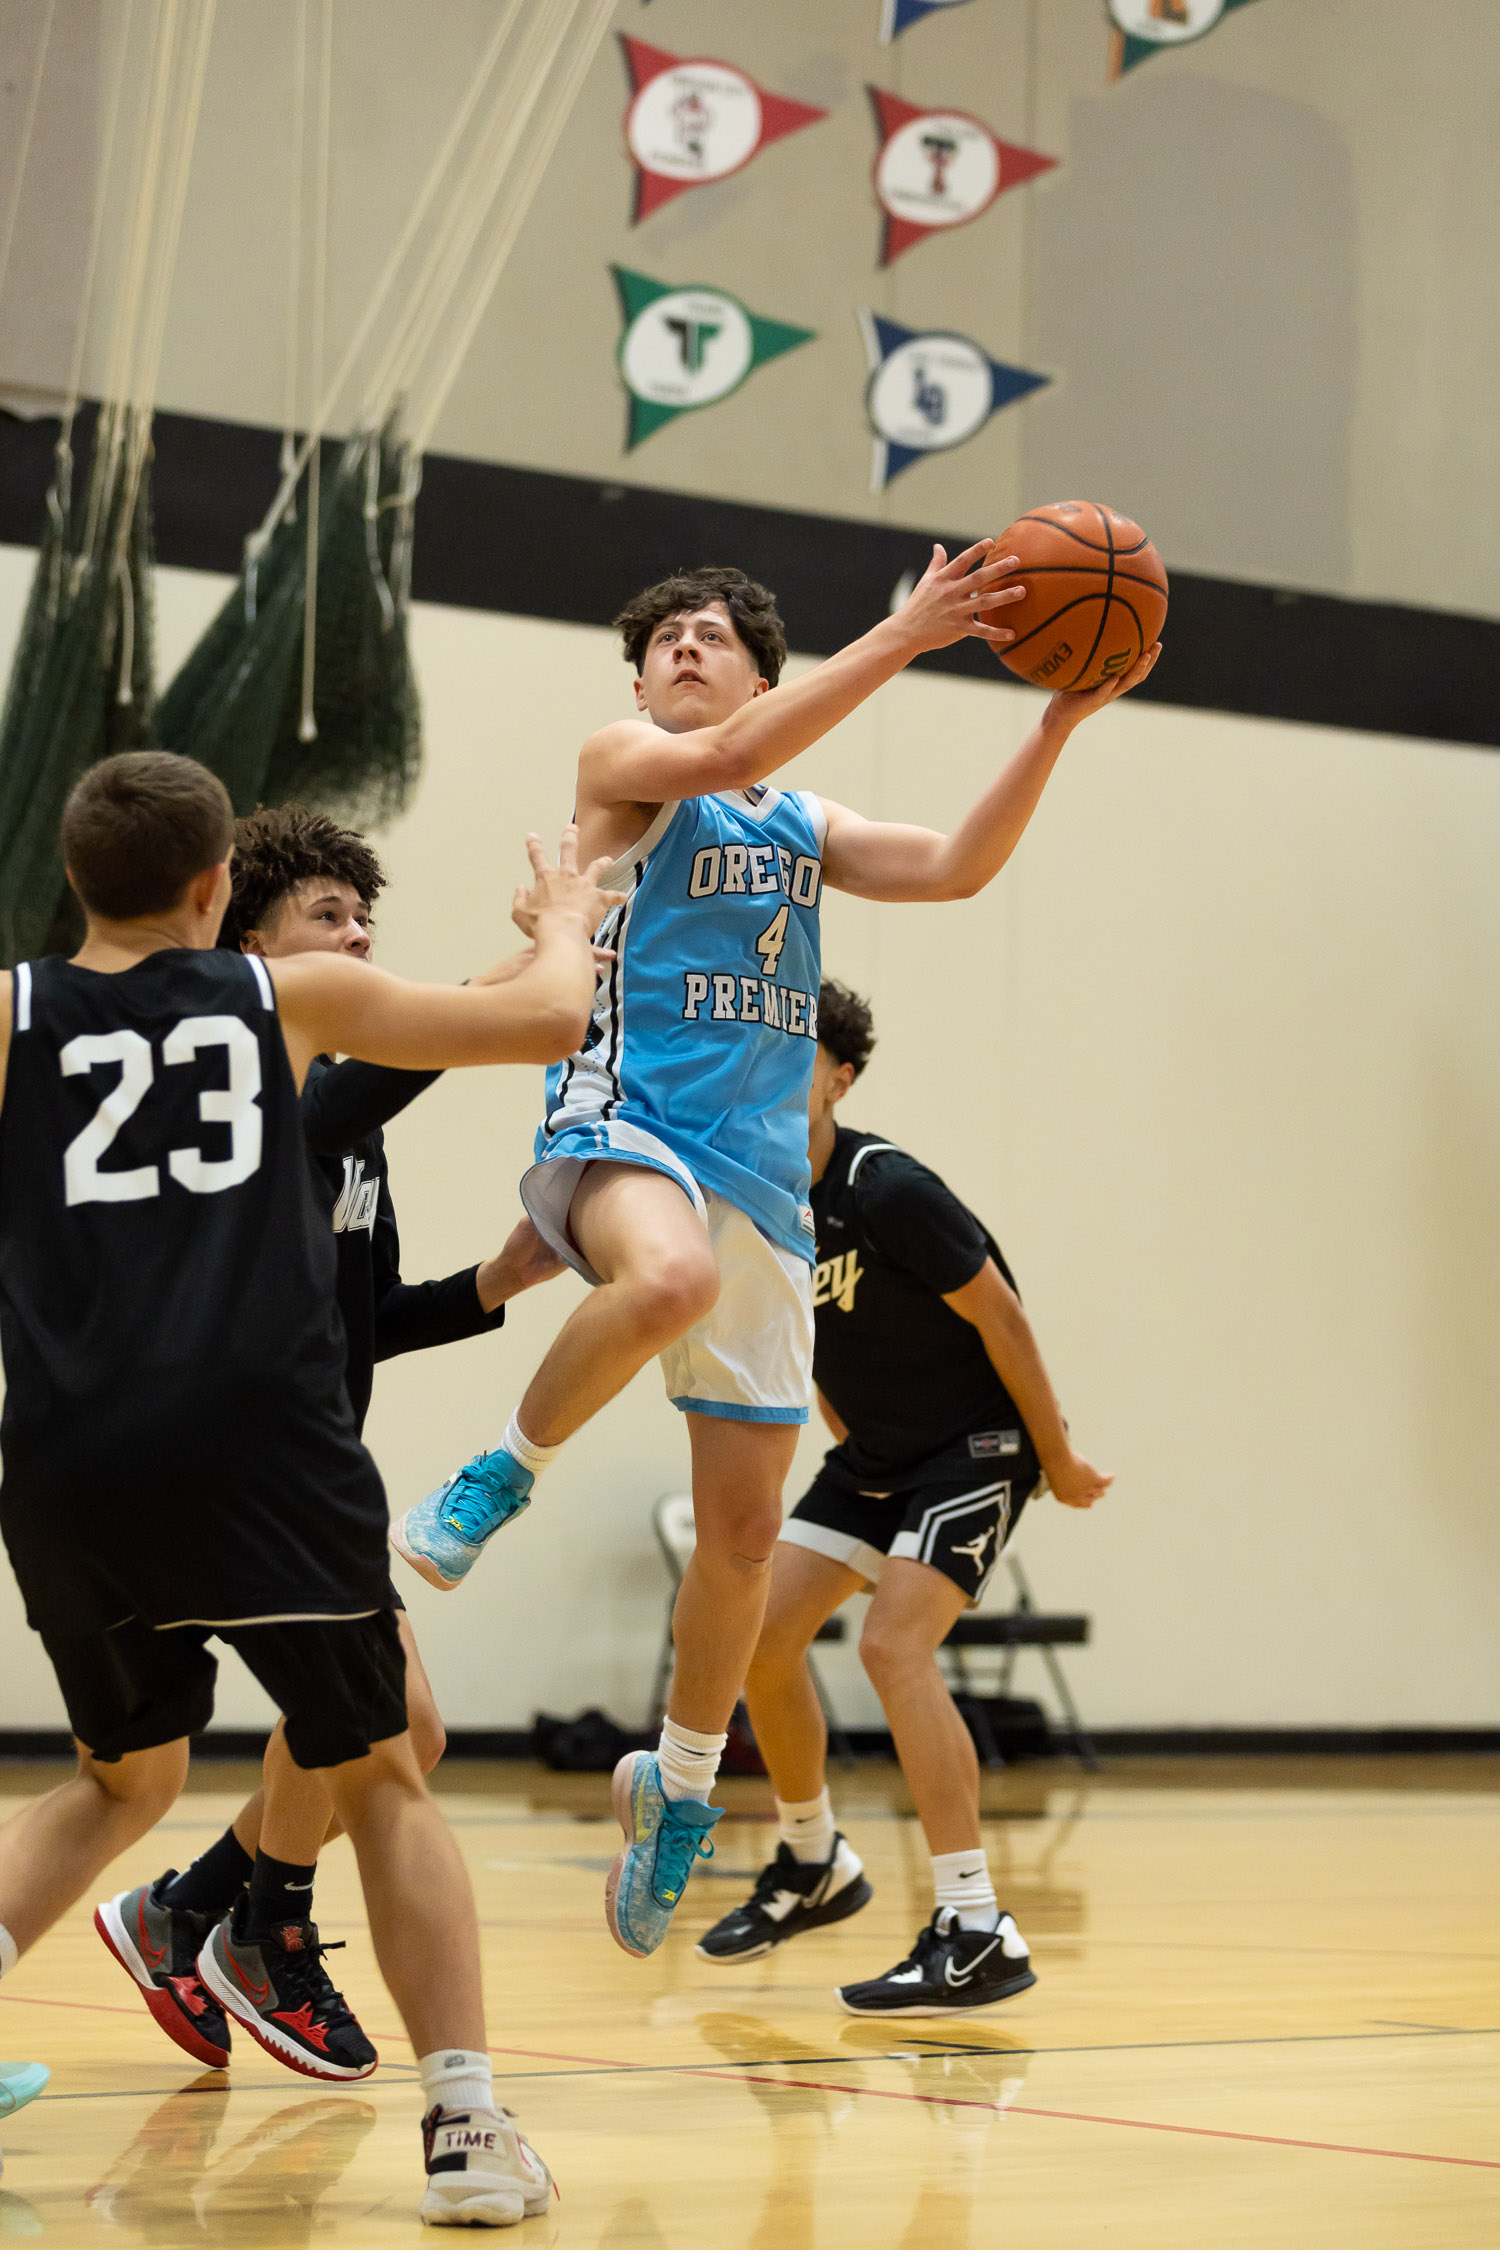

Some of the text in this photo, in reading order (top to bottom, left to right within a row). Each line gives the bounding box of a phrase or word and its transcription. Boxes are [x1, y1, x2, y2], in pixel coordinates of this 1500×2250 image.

[755, 904, 791, 976] 4
[682, 972, 818, 1041] PREMIER
[60, 1016, 262, 1206] 23
